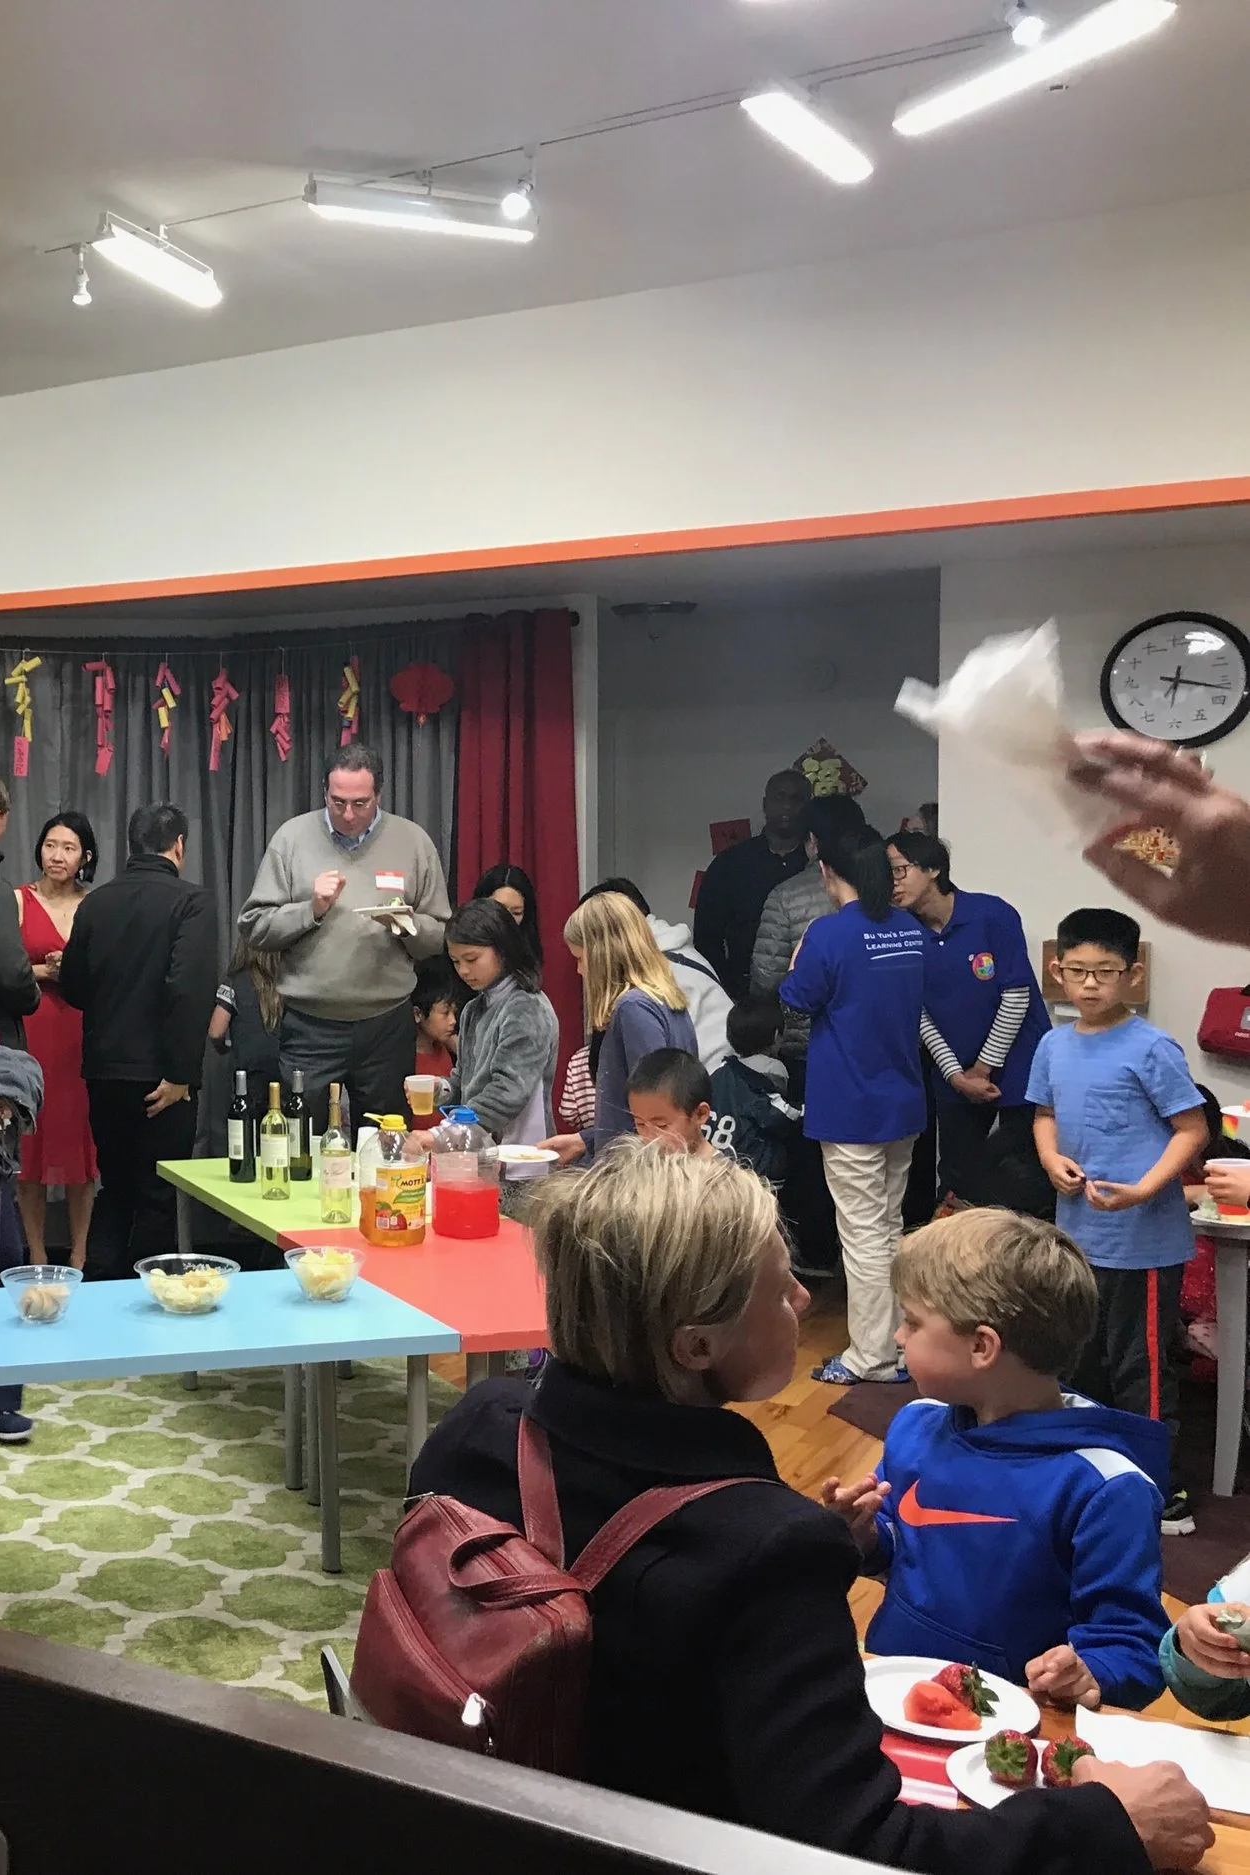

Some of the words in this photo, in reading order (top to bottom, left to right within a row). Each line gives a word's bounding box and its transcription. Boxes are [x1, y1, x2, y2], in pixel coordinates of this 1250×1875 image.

[1128, 657, 1143, 671] 十
[1128, 695, 1145, 707] 八
[1210, 694, 1227, 706] 四
[1140, 709, 1156, 723] 七
[1191, 708, 1208, 722] 五
[1167, 718, 1183, 729] 六
